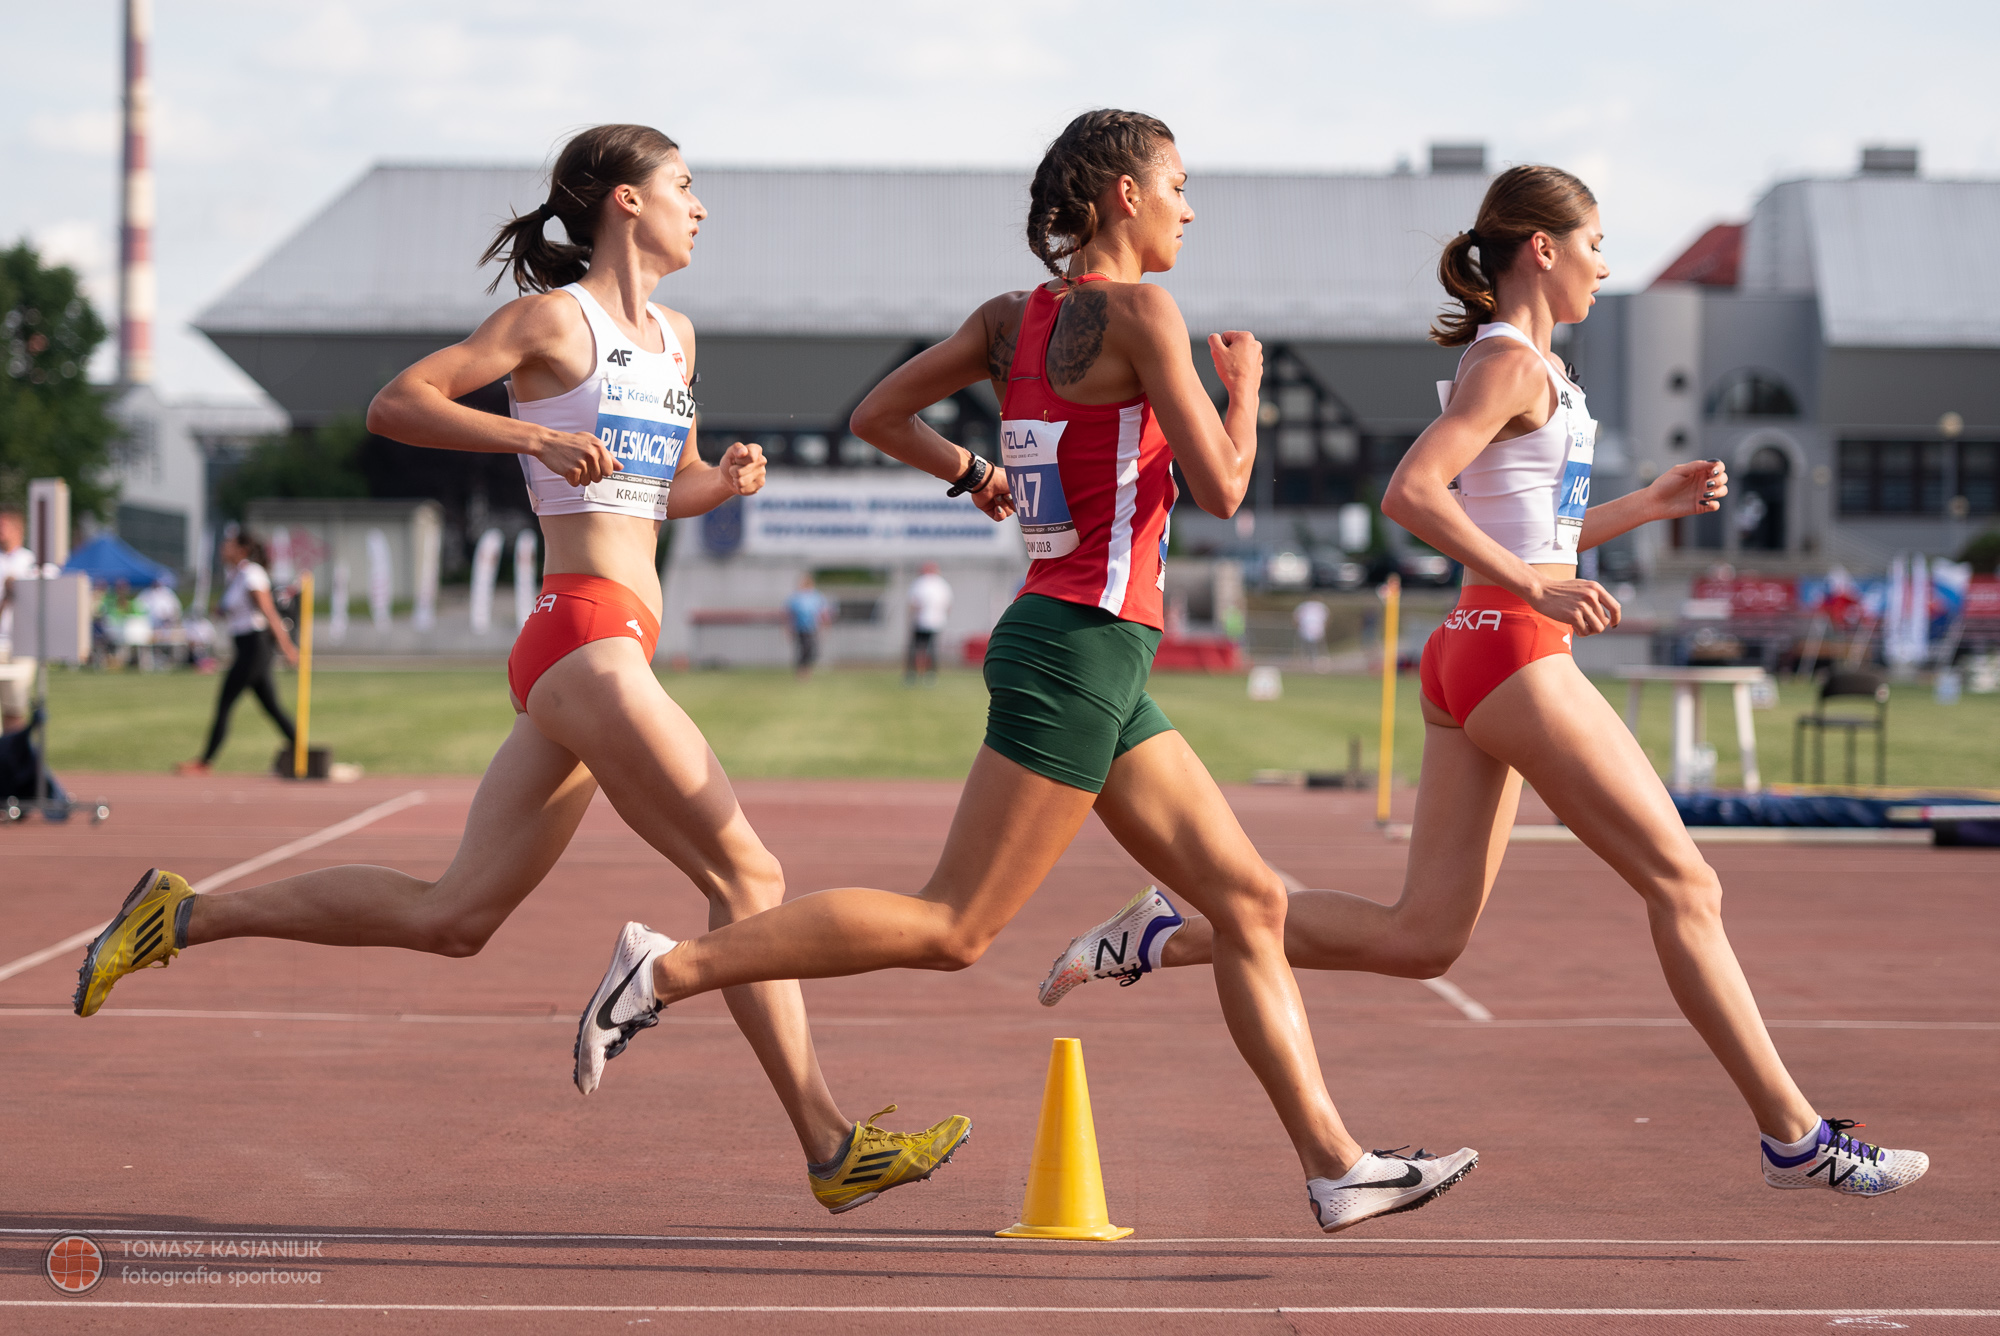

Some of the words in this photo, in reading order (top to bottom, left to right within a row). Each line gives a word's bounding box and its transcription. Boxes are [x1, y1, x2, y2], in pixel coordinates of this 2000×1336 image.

[607, 348, 633, 367] 4F
[627, 388, 660, 404] Kraków
[1036, 540, 1052, 553] 2018
[1444, 609, 1502, 631] SKA
